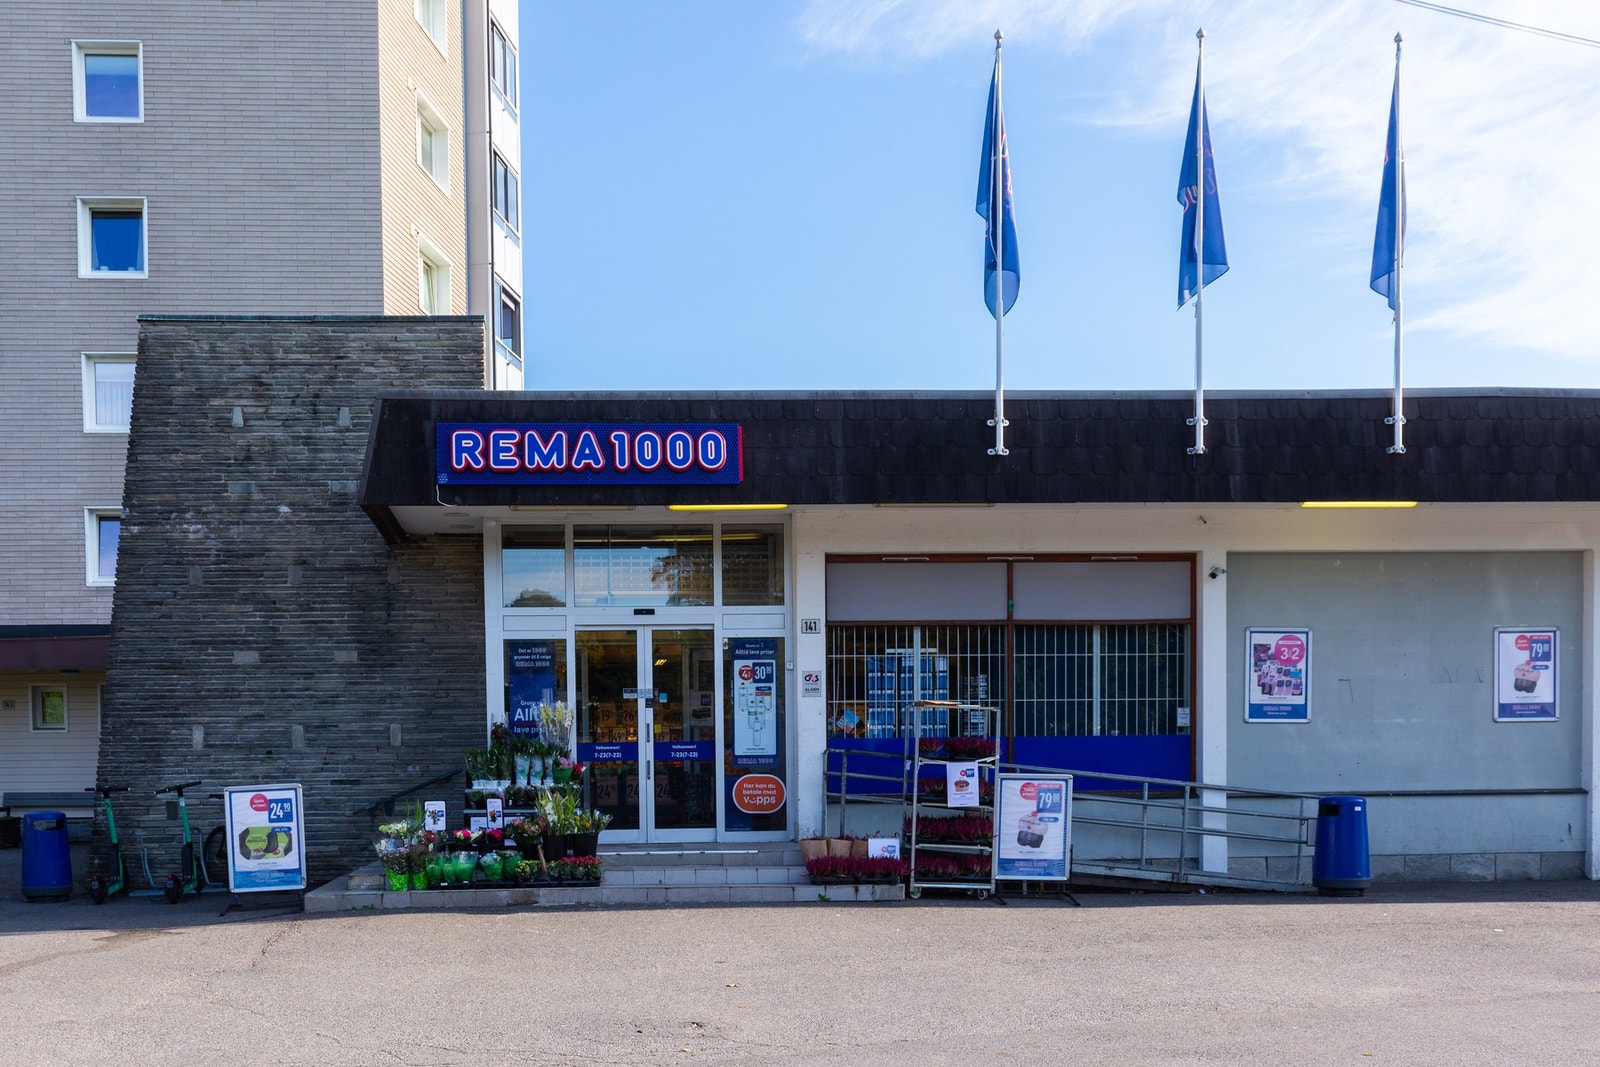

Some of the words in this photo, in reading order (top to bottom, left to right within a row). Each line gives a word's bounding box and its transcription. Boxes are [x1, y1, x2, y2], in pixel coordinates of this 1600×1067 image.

[451, 430, 606, 472] REMA
[610, 430, 728, 472] 1000
[804, 621, 817, 632] 141
[1531, 643, 1543, 658] 79
[754, 666, 766, 680] 30
[1039, 792, 1052, 809] 79
[270, 802, 283, 819] 24
